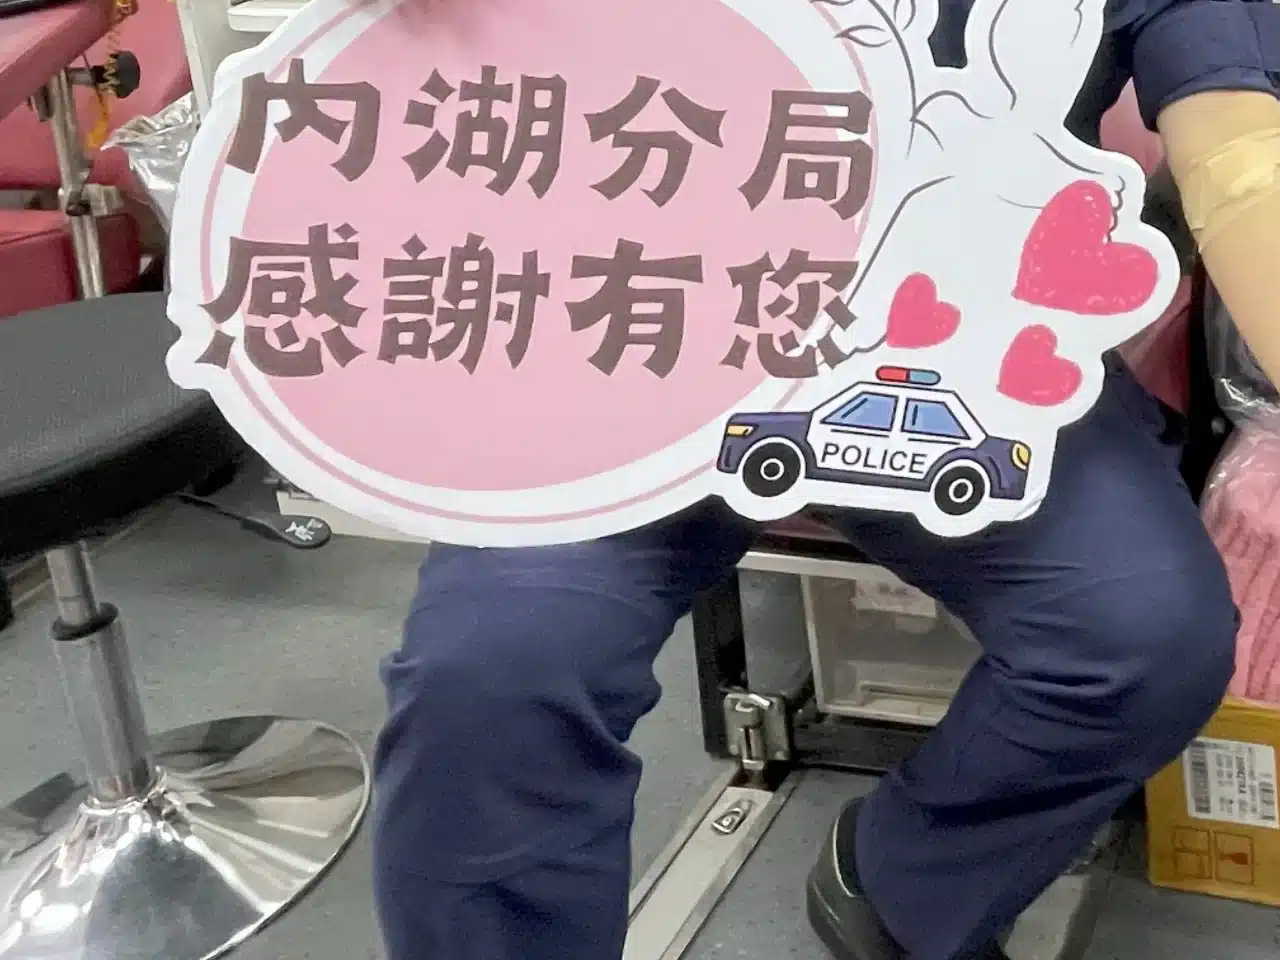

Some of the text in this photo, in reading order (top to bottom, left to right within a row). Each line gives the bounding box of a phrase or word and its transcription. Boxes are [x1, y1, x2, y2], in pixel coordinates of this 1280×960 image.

[226, 58, 873, 220] 內湖分局
[195, 223, 860, 379] 感謝有您
[821, 443, 928, 474] POLICE
